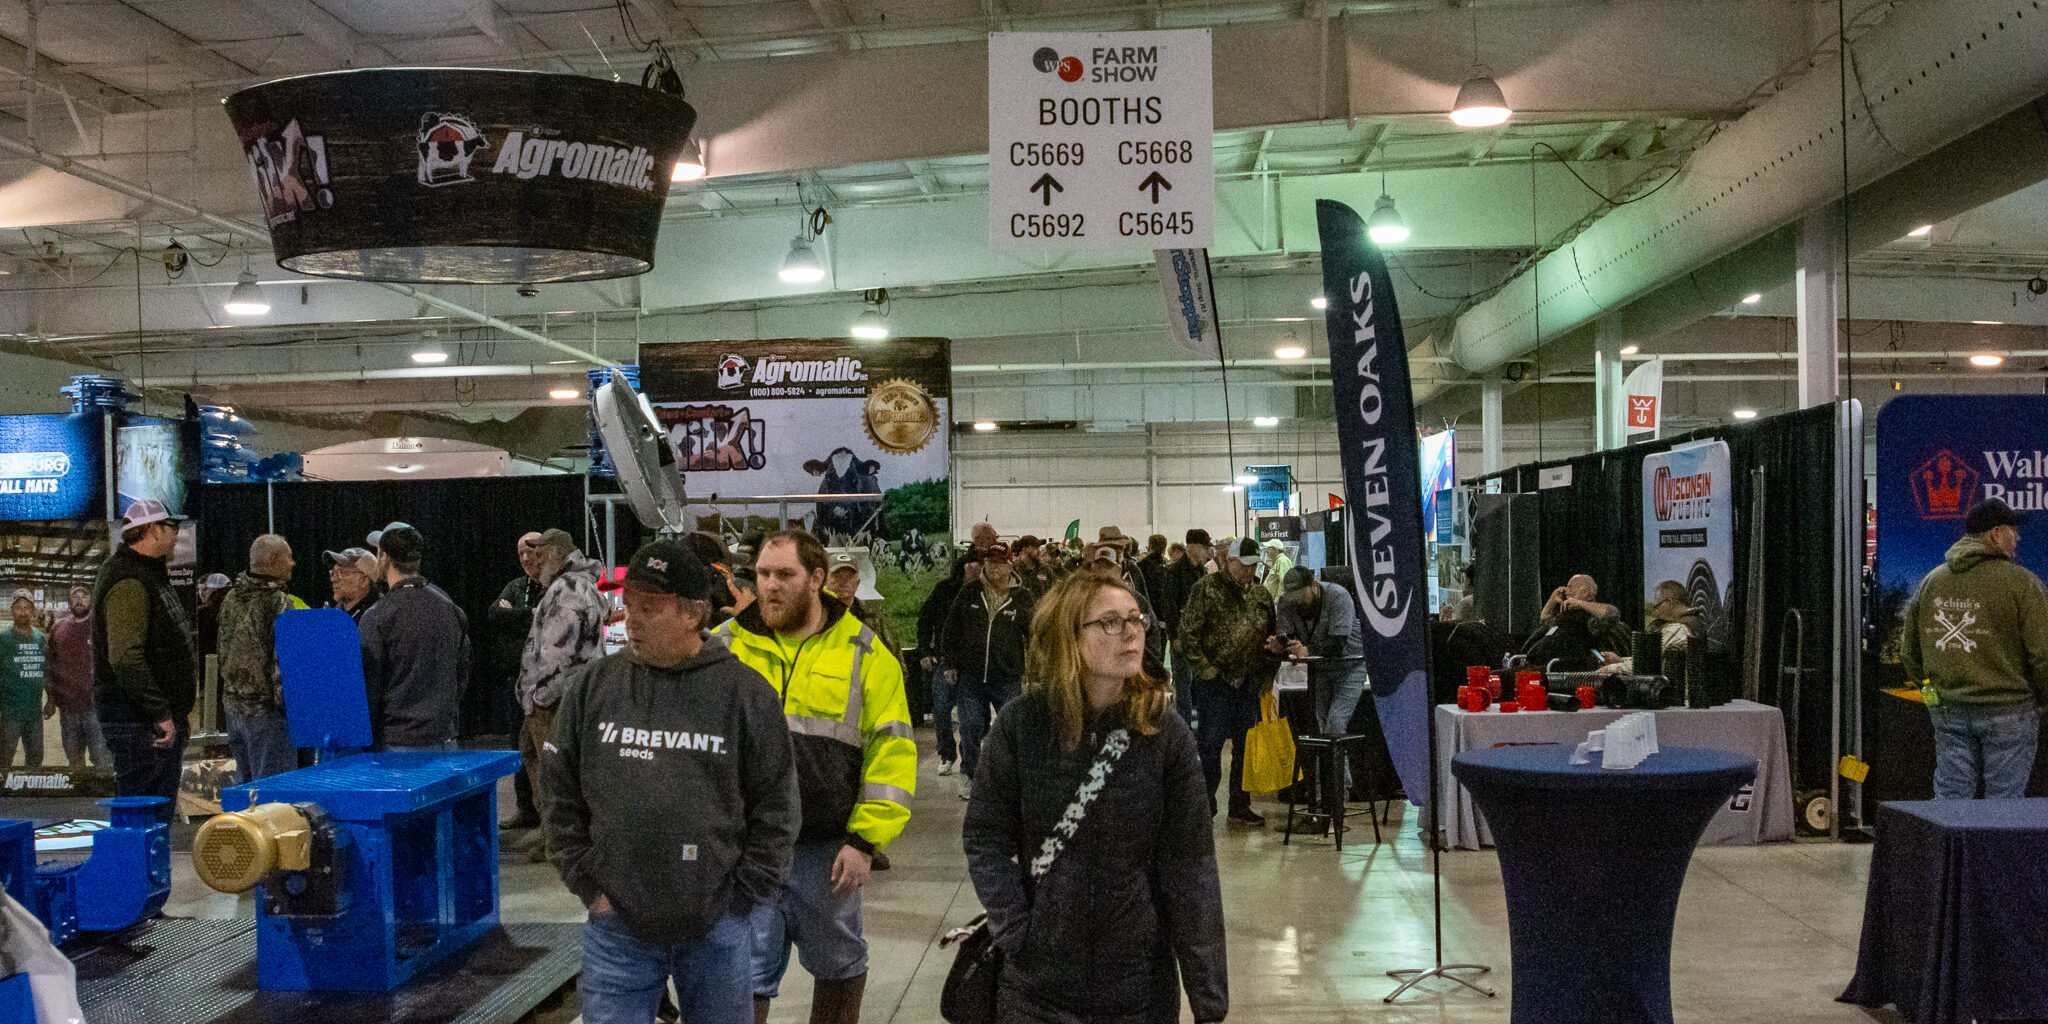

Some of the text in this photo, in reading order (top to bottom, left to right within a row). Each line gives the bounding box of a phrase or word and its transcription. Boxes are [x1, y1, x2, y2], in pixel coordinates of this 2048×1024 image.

[1044, 60, 1071, 72] WPS
[1092, 46, 1158, 65] FARM
[1091, 66, 1158, 83] SHOW
[1039, 96, 1162, 126] BOOTHS
[1010, 141, 1085, 166] C5669
[1118, 140, 1193, 165] C5668
[1010, 213, 1086, 238] C5692
[1119, 211, 1194, 236] C5645
[750, 387, 770, 397] (800)
[815, 386, 866, 396] agromatic.net
[1350, 271, 1398, 610] SEVEN OAKS
[25, 479, 58, 493] MATS
[1667, 472, 1711, 501] WISCONSIN
[1673, 498, 1710, 520] TUBING
[621, 727, 725, 754] BREVANT
[619, 748, 653, 760] seeds
